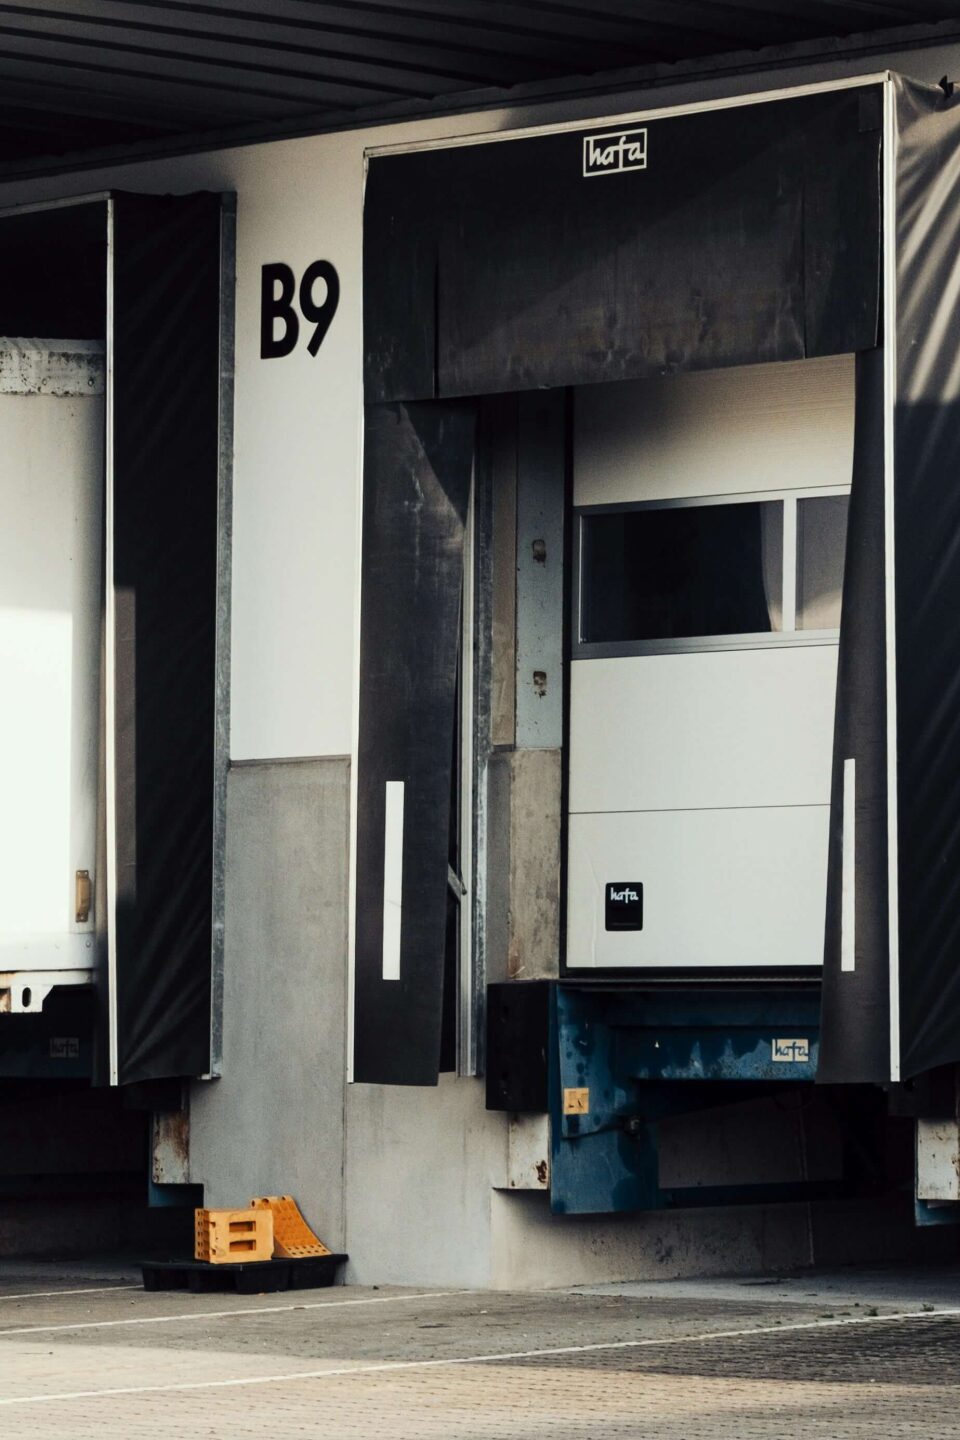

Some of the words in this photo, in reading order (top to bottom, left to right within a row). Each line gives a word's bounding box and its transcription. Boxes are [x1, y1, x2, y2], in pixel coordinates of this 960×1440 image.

[588, 134, 646, 169] hafa
[260, 259, 340, 360] B9
[610, 886, 639, 904] hafa
[773, 1039, 809, 1061] hafa
